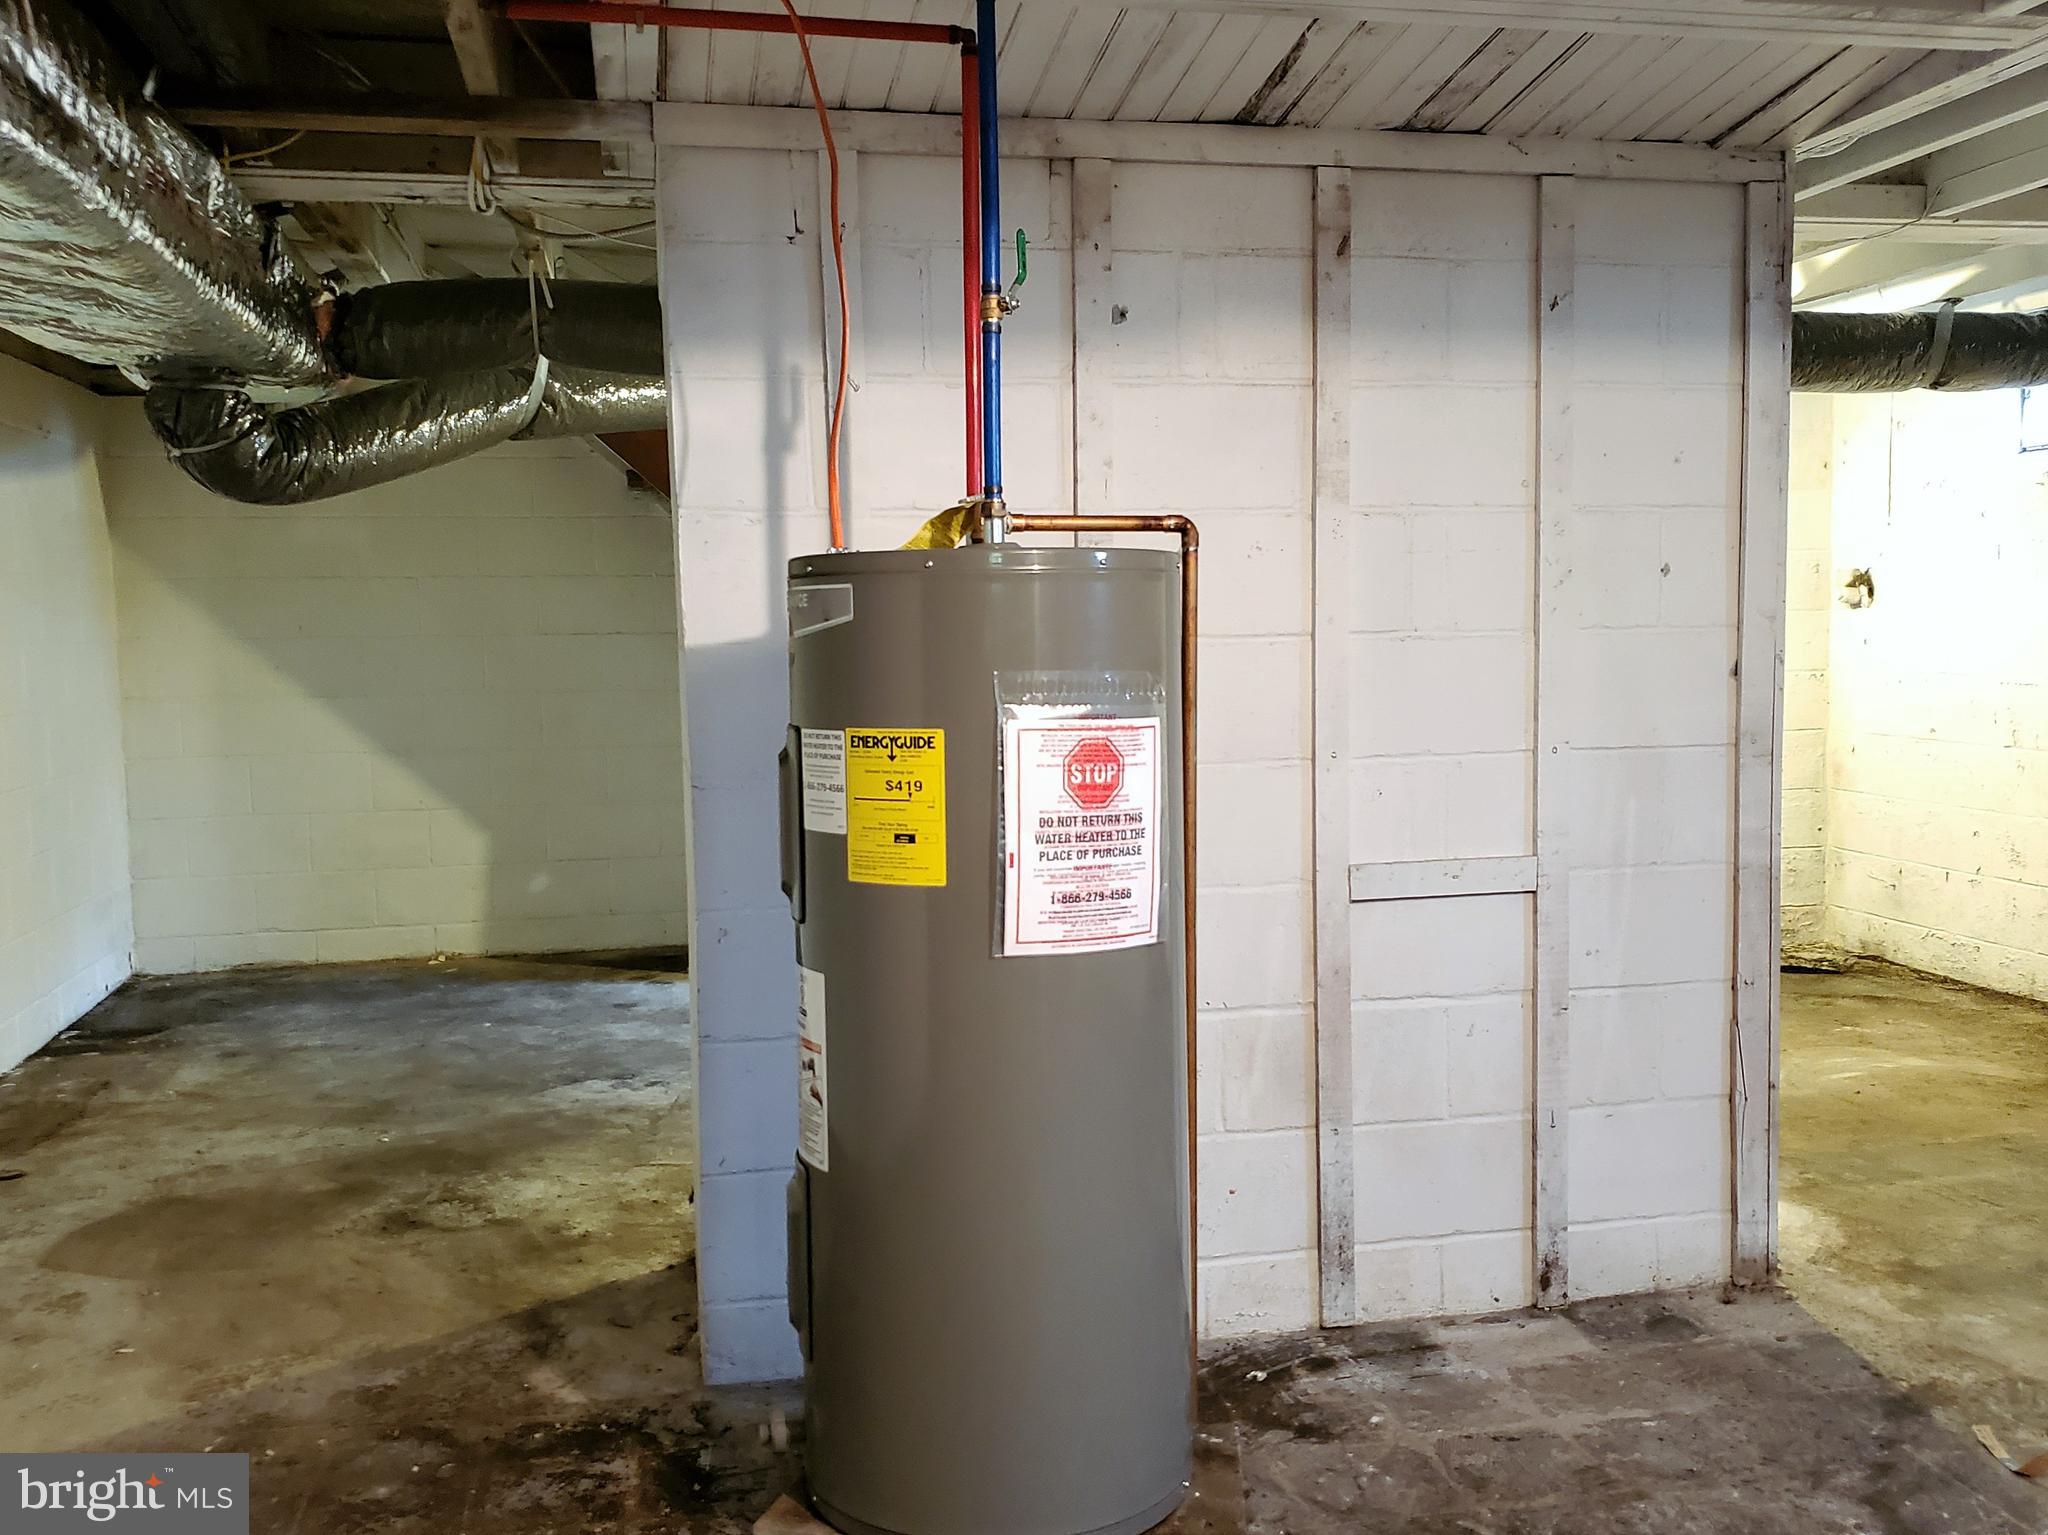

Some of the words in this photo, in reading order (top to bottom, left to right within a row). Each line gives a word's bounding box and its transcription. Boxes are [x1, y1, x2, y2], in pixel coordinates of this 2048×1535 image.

[850, 735, 936, 750] ENERGYGUIDE
[1070, 762, 1119, 785] STOP
[1039, 816, 1054, 828] DO
[1057, 816, 1079, 827] NOT
[1082, 813, 1121, 827] RETURN
[1122, 812, 1143, 824] THIS
[1035, 832, 1072, 845] WATER
[1075, 830, 1113, 843] HEATER
[1115, 829, 1127, 841] TO
[1130, 828, 1146, 839] THE
[1039, 850, 1073, 862] PLACE
[1076, 849, 1089, 860] OF
[1092, 846, 1142, 859] PURCHASE
[1051, 888, 1132, 905] 1-866-279-4566
